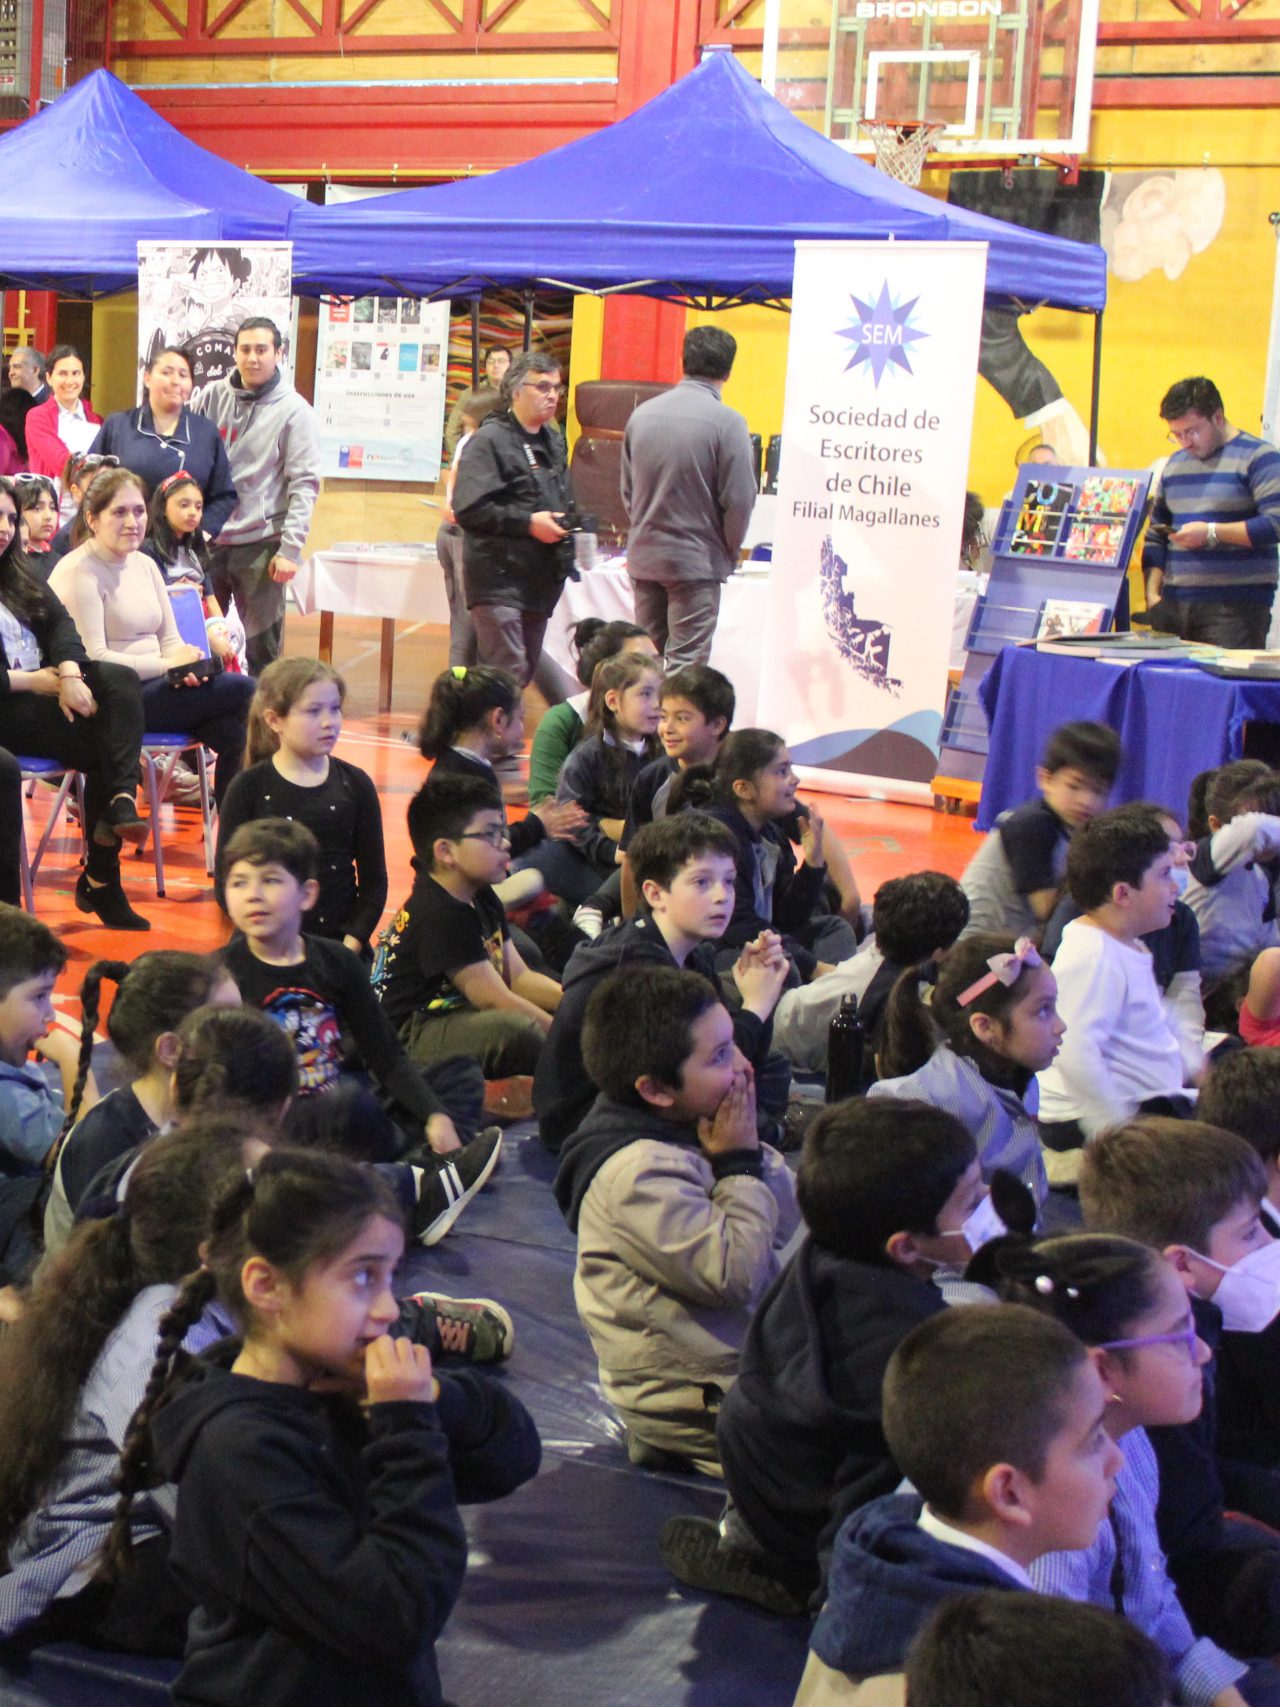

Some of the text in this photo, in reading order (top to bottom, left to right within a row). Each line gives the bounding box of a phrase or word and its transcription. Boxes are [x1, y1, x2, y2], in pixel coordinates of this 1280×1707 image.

[856, 0, 1002, 18] BRONSON
[861, 323, 903, 345] SEM
[206, 364, 223, 377] del
[809, 404, 941, 431] Sociedad de
[820, 438, 923, 464] Escritores
[825, 472, 912, 497] de Chile
[792, 501, 941, 528] Filial Magallanes
